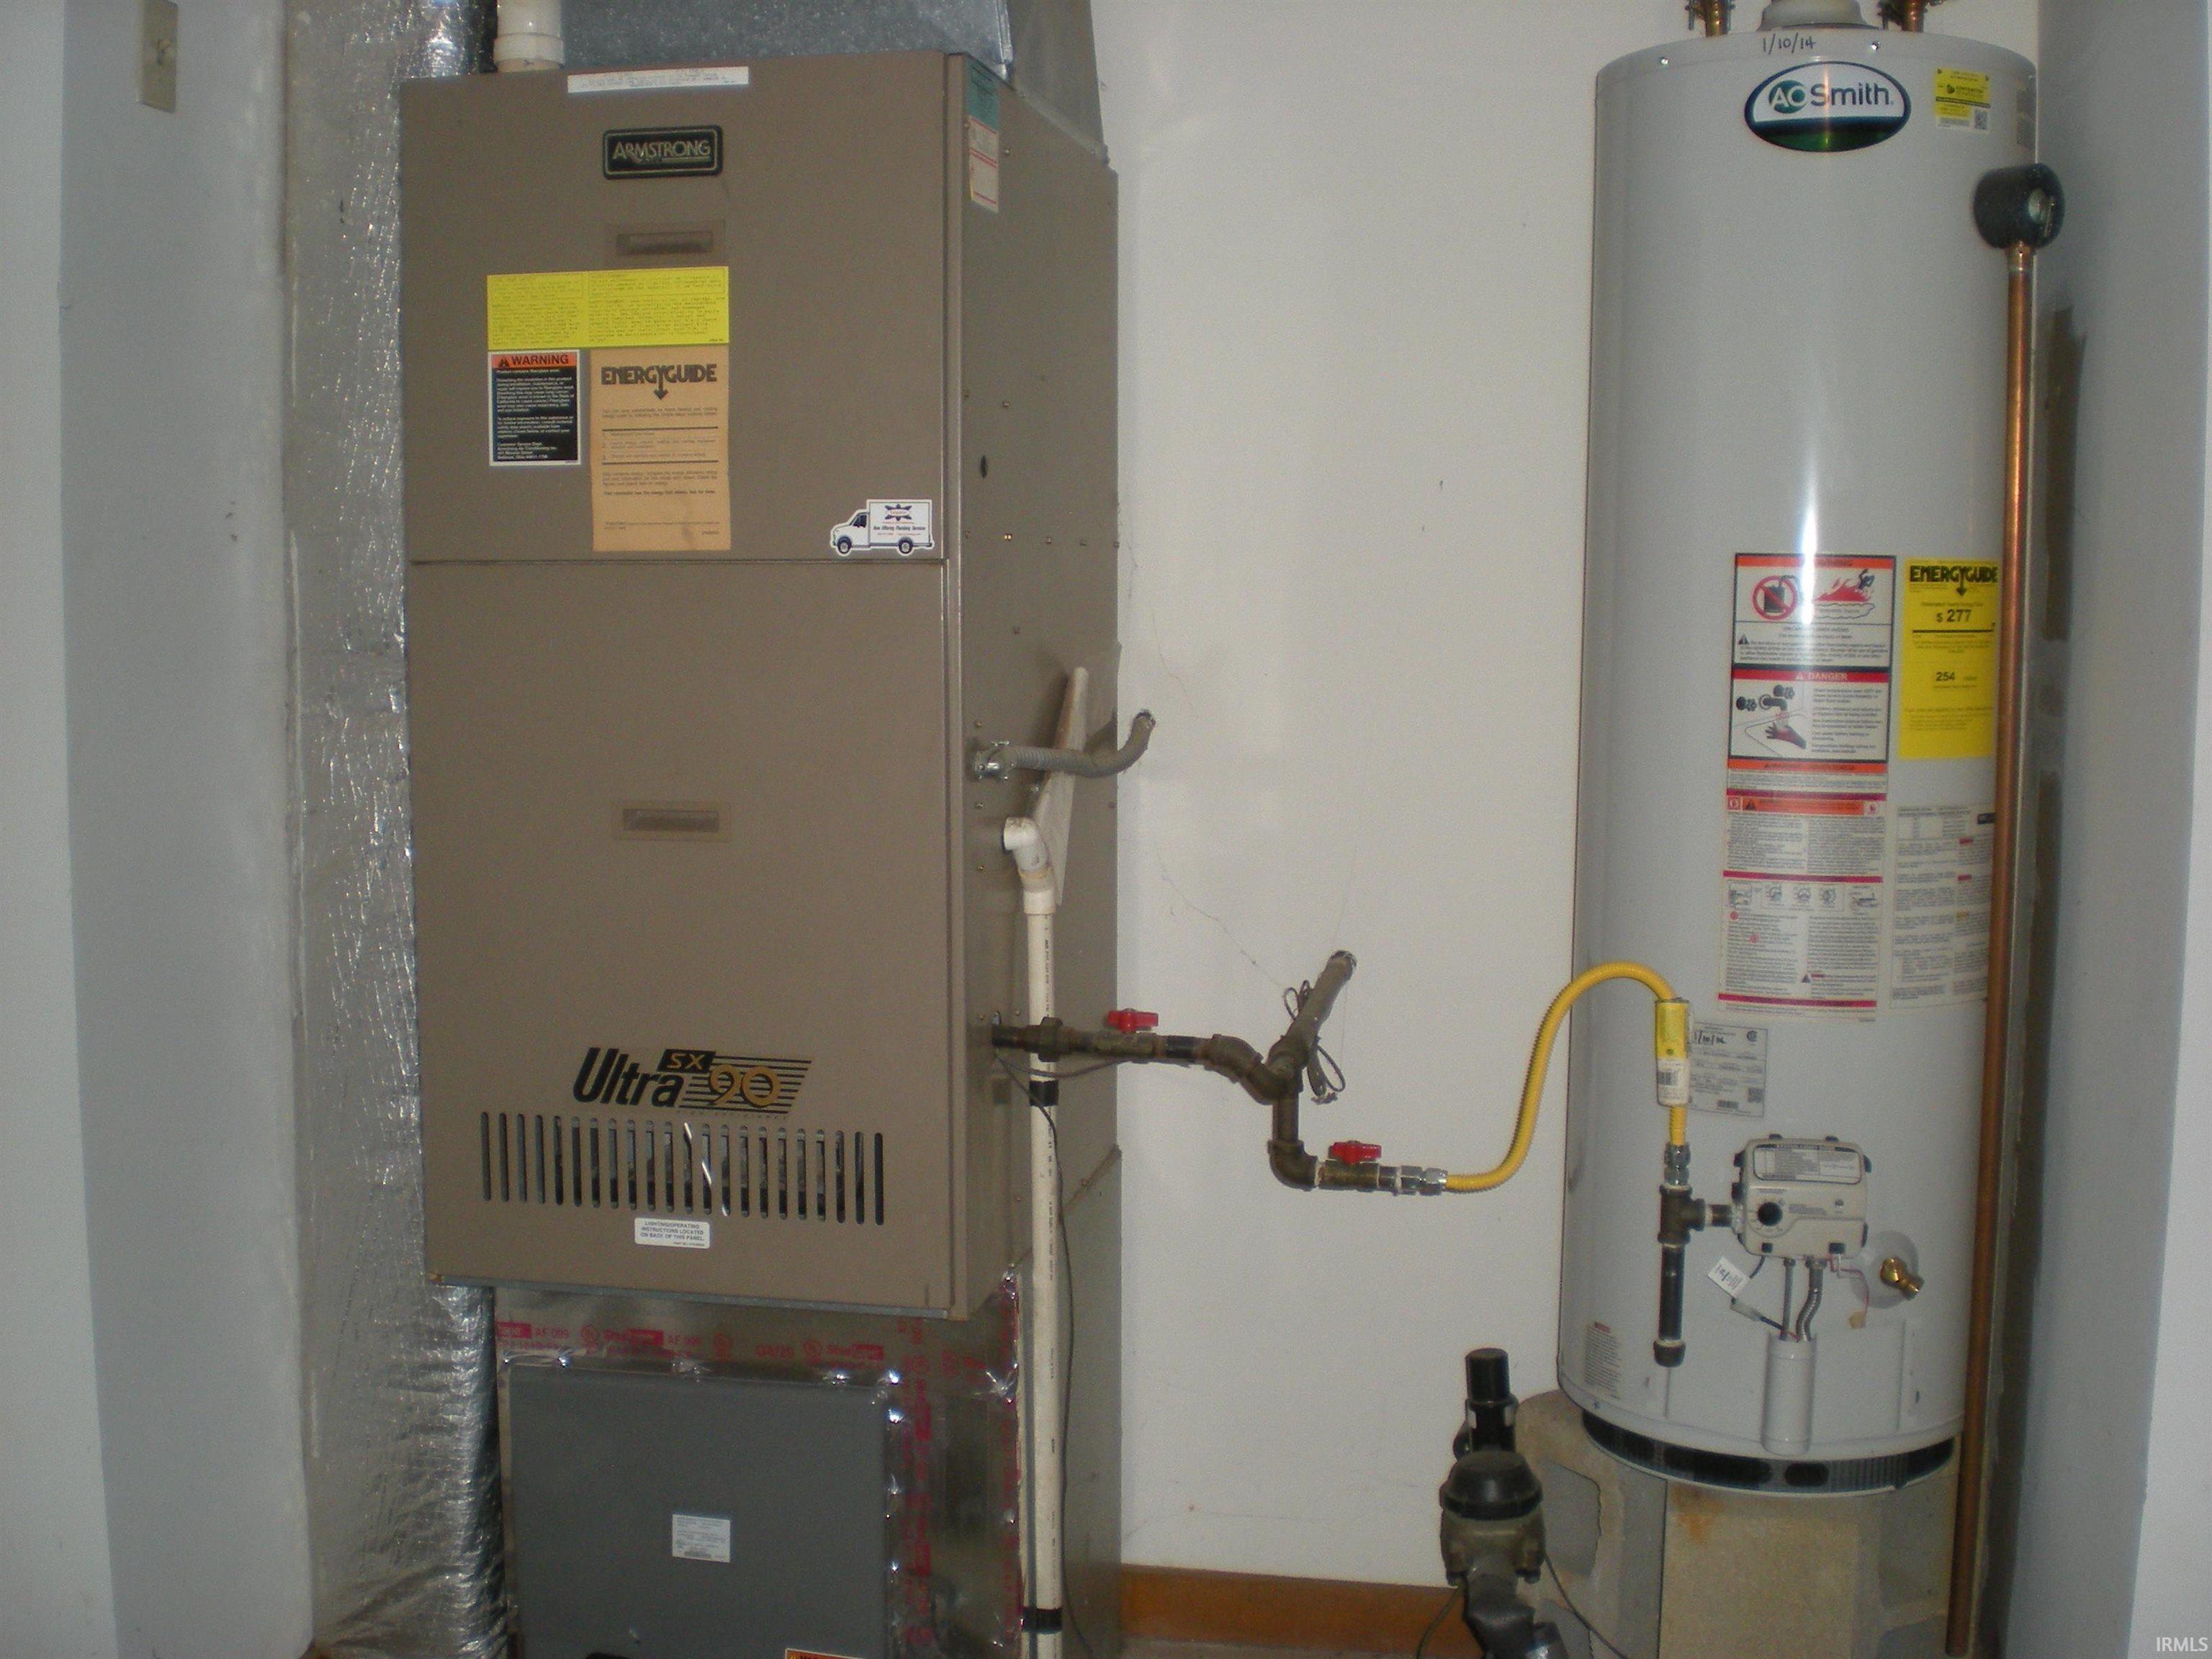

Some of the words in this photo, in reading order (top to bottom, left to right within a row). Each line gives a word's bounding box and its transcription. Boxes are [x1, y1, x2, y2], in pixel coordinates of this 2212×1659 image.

[1763, 32, 1816, 55] 1/10/14
[1810, 83, 1889, 106] Smith
[612, 140, 711, 161] ARMSTRONG
[511, 354, 569, 365] WARNING
[601, 364, 717, 385] ENERGYGUIDE
[1946, 608, 1972, 622] 277
[1808, 672, 1848, 680] DANGER
[1936, 672, 1956, 681] 254
[573, 1047, 685, 1107] Ultra
[667, 1053, 706, 1071] SX
[709, 1064, 782, 1107] 90
